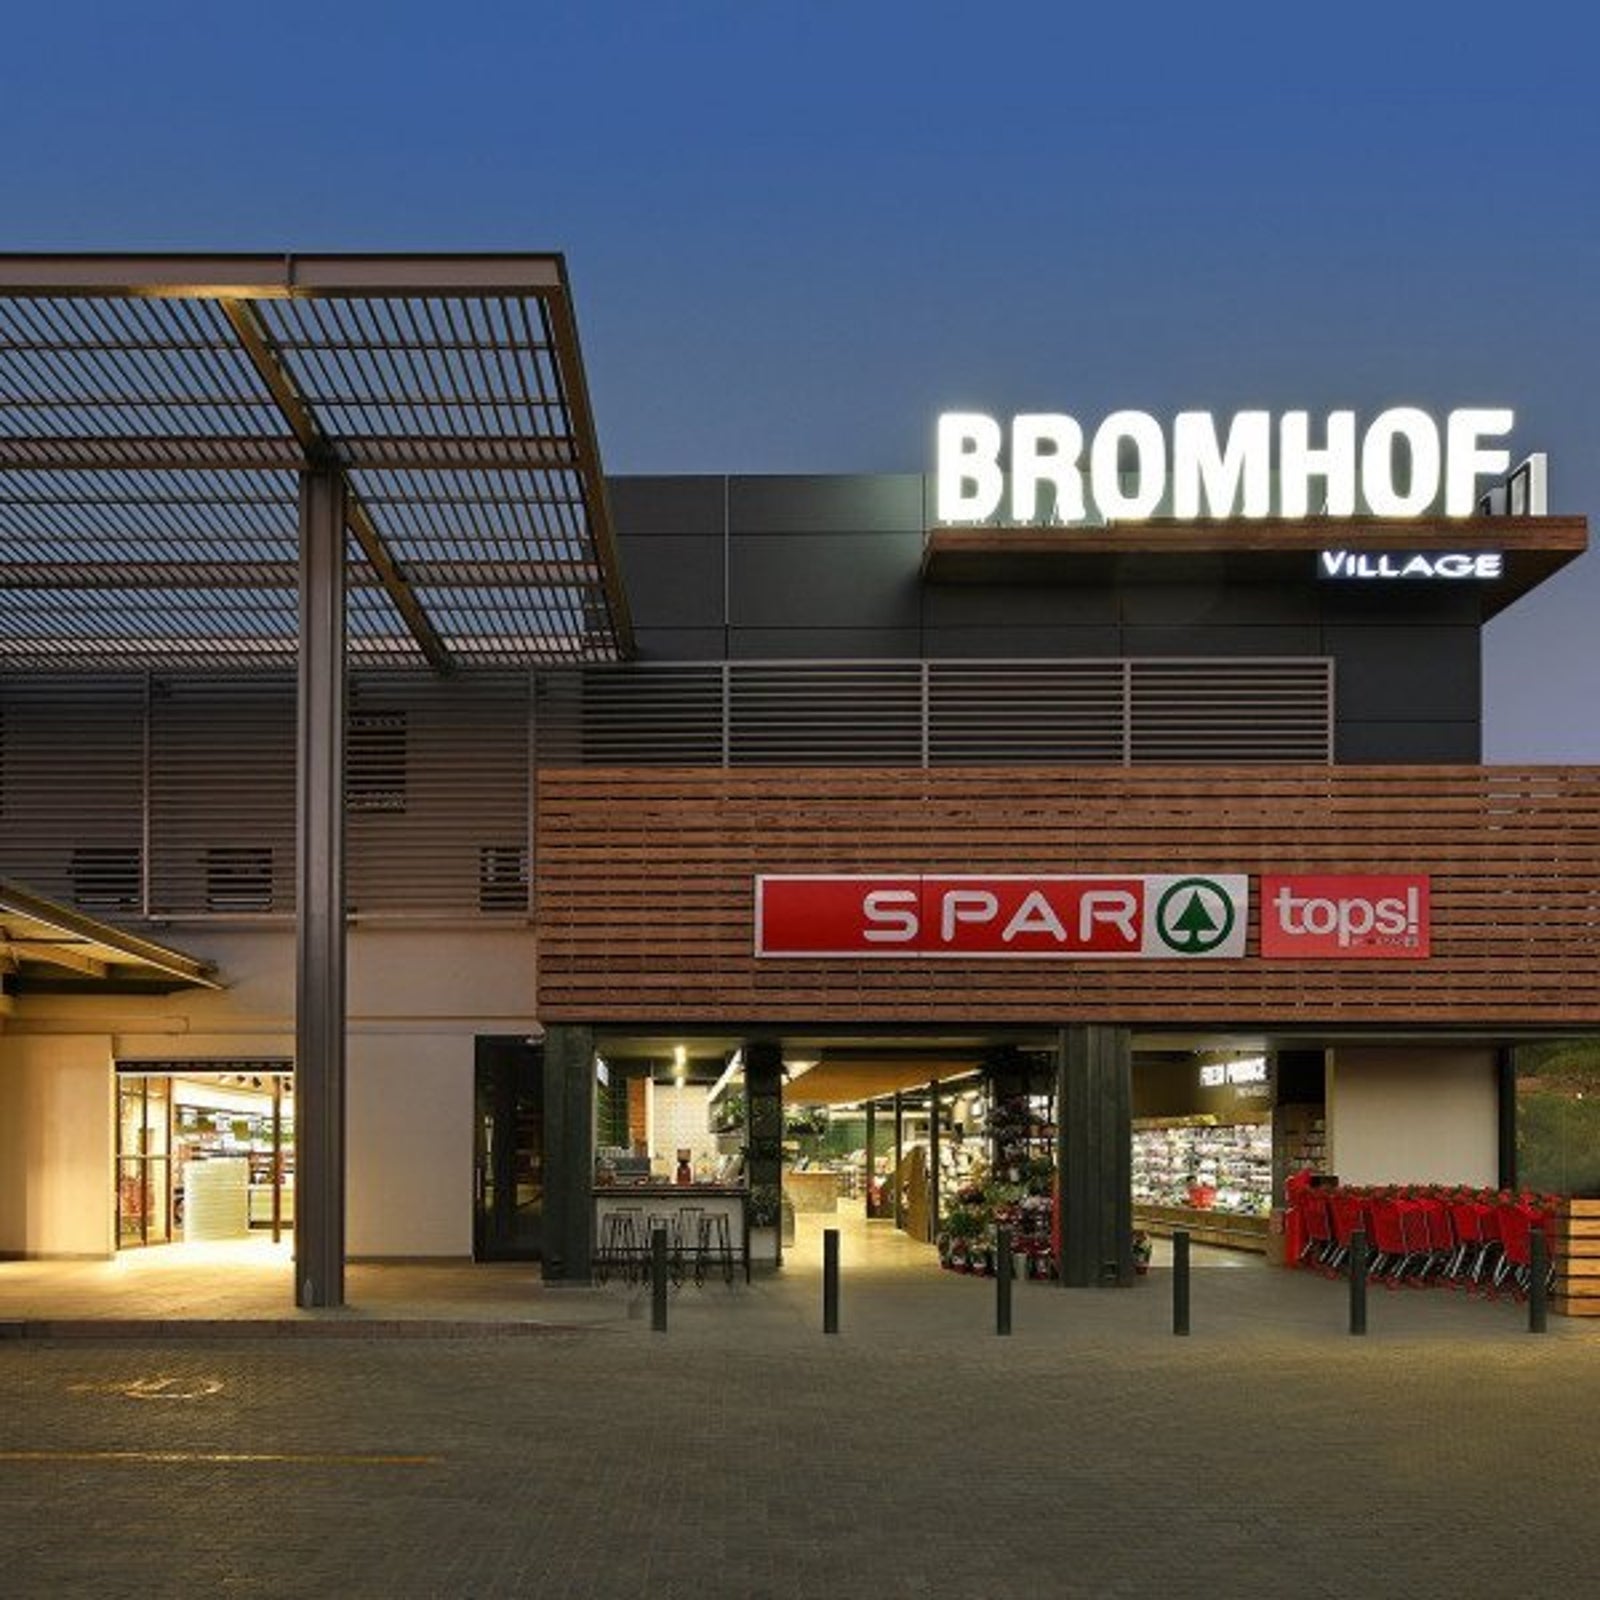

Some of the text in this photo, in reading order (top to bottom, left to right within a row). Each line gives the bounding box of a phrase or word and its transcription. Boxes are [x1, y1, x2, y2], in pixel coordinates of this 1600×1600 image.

[937, 407, 1514, 520] BROMHOF
[1321, 550, 1502, 578] VILLAGE
[862, 889, 1138, 942] SPAR
[1273, 886, 1419, 948] tops!
